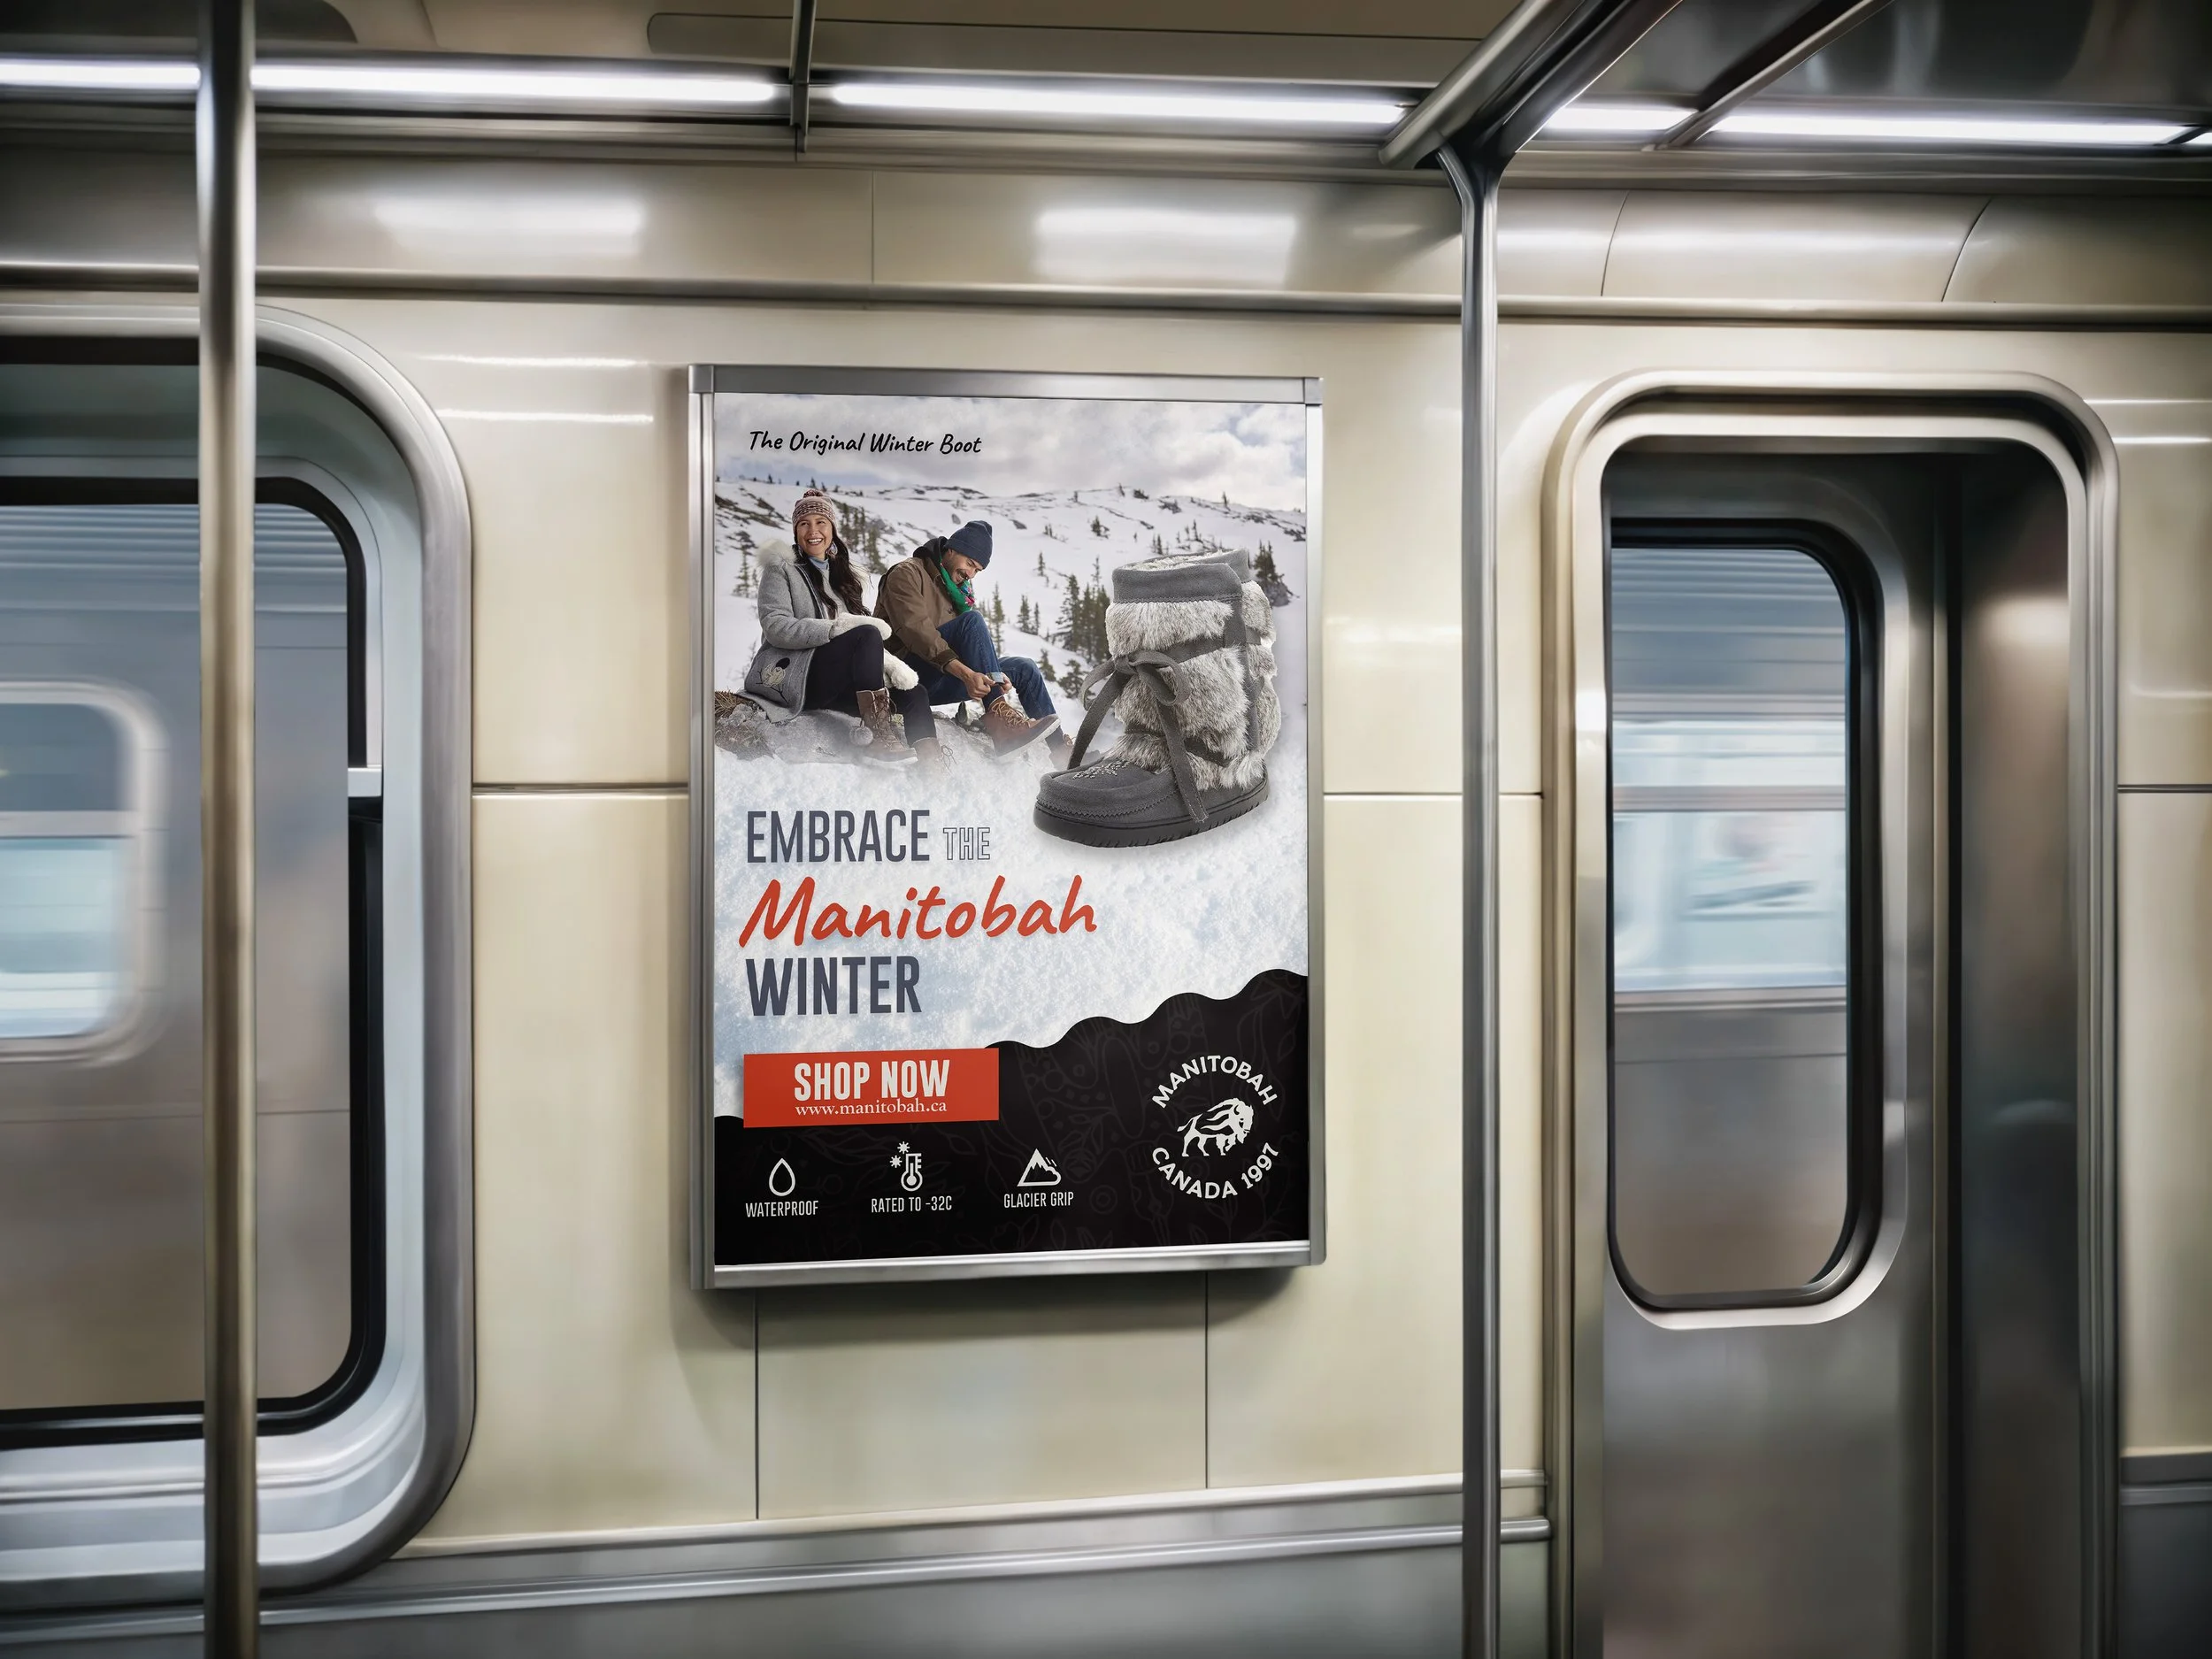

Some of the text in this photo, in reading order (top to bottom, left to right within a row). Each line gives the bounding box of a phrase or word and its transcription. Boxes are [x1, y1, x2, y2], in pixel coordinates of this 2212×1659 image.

[749, 430, 982, 456] The Original Winter Boot
[747, 809, 991, 864] EMBRACE THE
[739, 875, 1097, 948] Manitobah
[745, 956, 923, 1017] WINTER
[794, 1059, 950, 1102] SHOP NOW
[1151, 1055, 1278, 1109] MANITOBAH
[795, 1097, 948, 1116] www.manitobah.ca
[1152, 1141, 1279, 1199] CANADA 1997
[745, 1200, 819, 1217] WATERPROOF
[871, 1195, 952, 1213] RATED TO -32C
[1003, 1191, 1074, 1209] GLACIER GRIP
